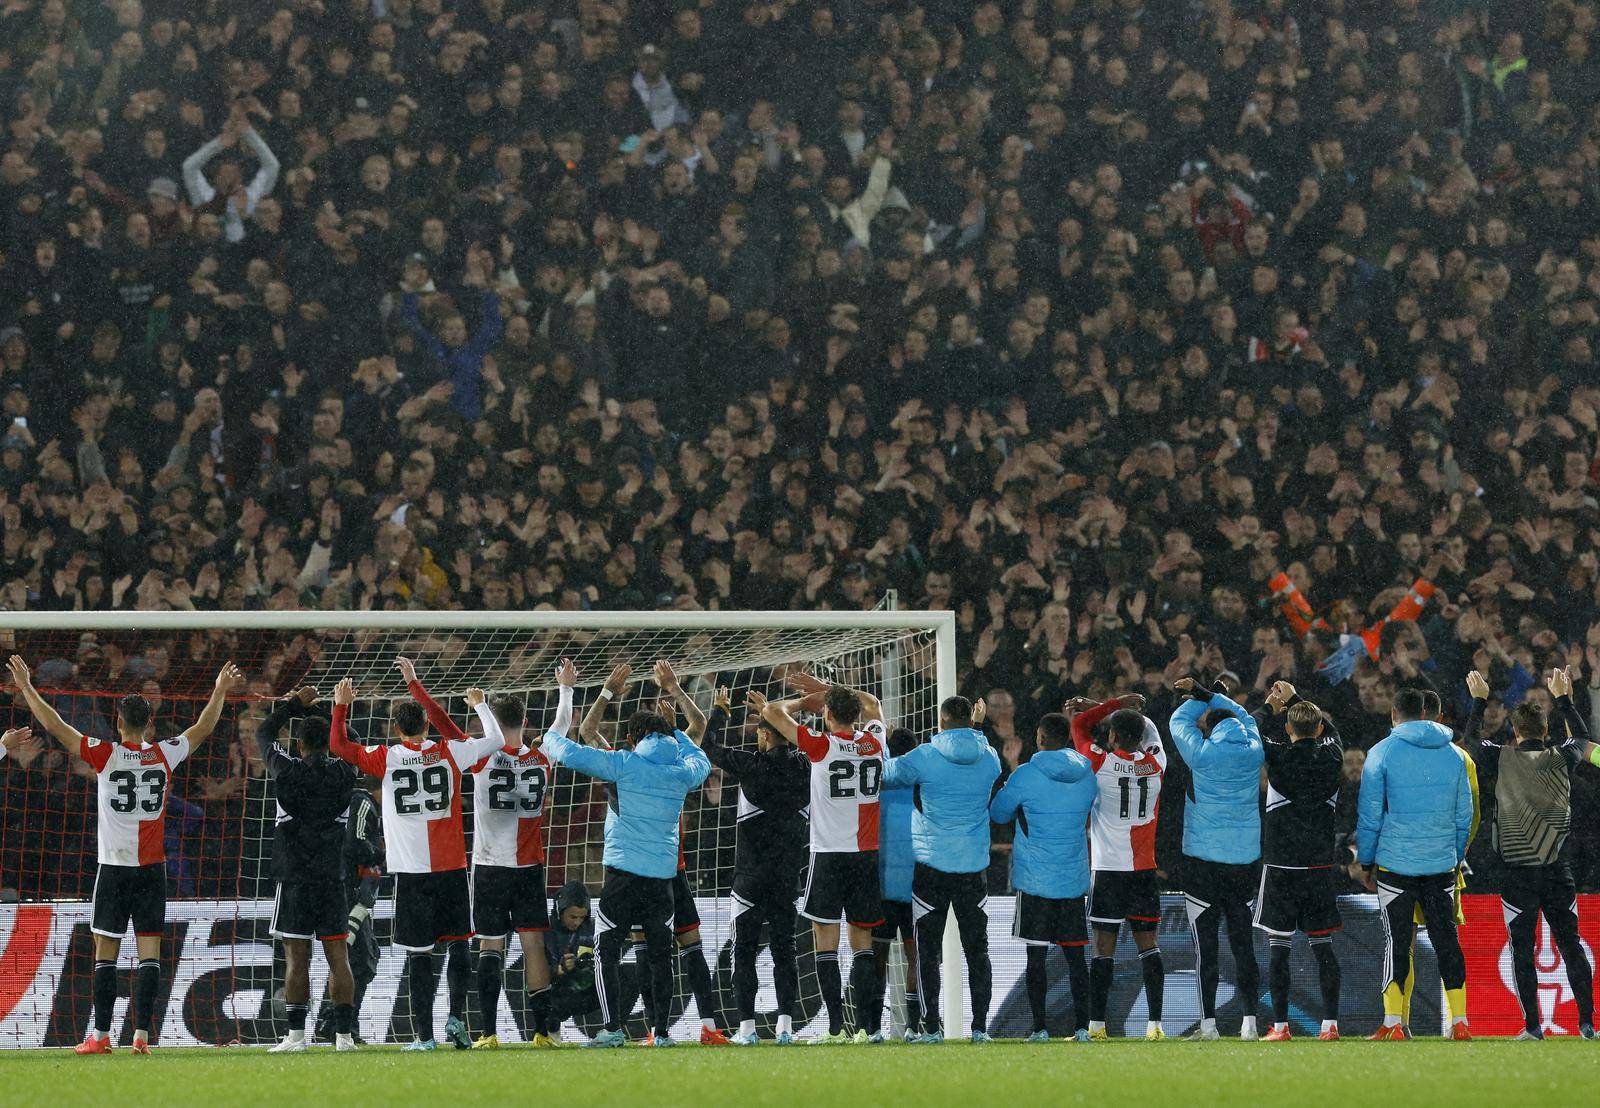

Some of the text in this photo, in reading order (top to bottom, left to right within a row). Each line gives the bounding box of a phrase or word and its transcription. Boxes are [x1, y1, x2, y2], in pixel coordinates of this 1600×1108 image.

[109, 770, 167, 813] 33
[392, 766, 450, 814] 29
[489, 768, 545, 811] 23
[829, 759, 882, 798] 20
[1118, 776, 1148, 819] 11
